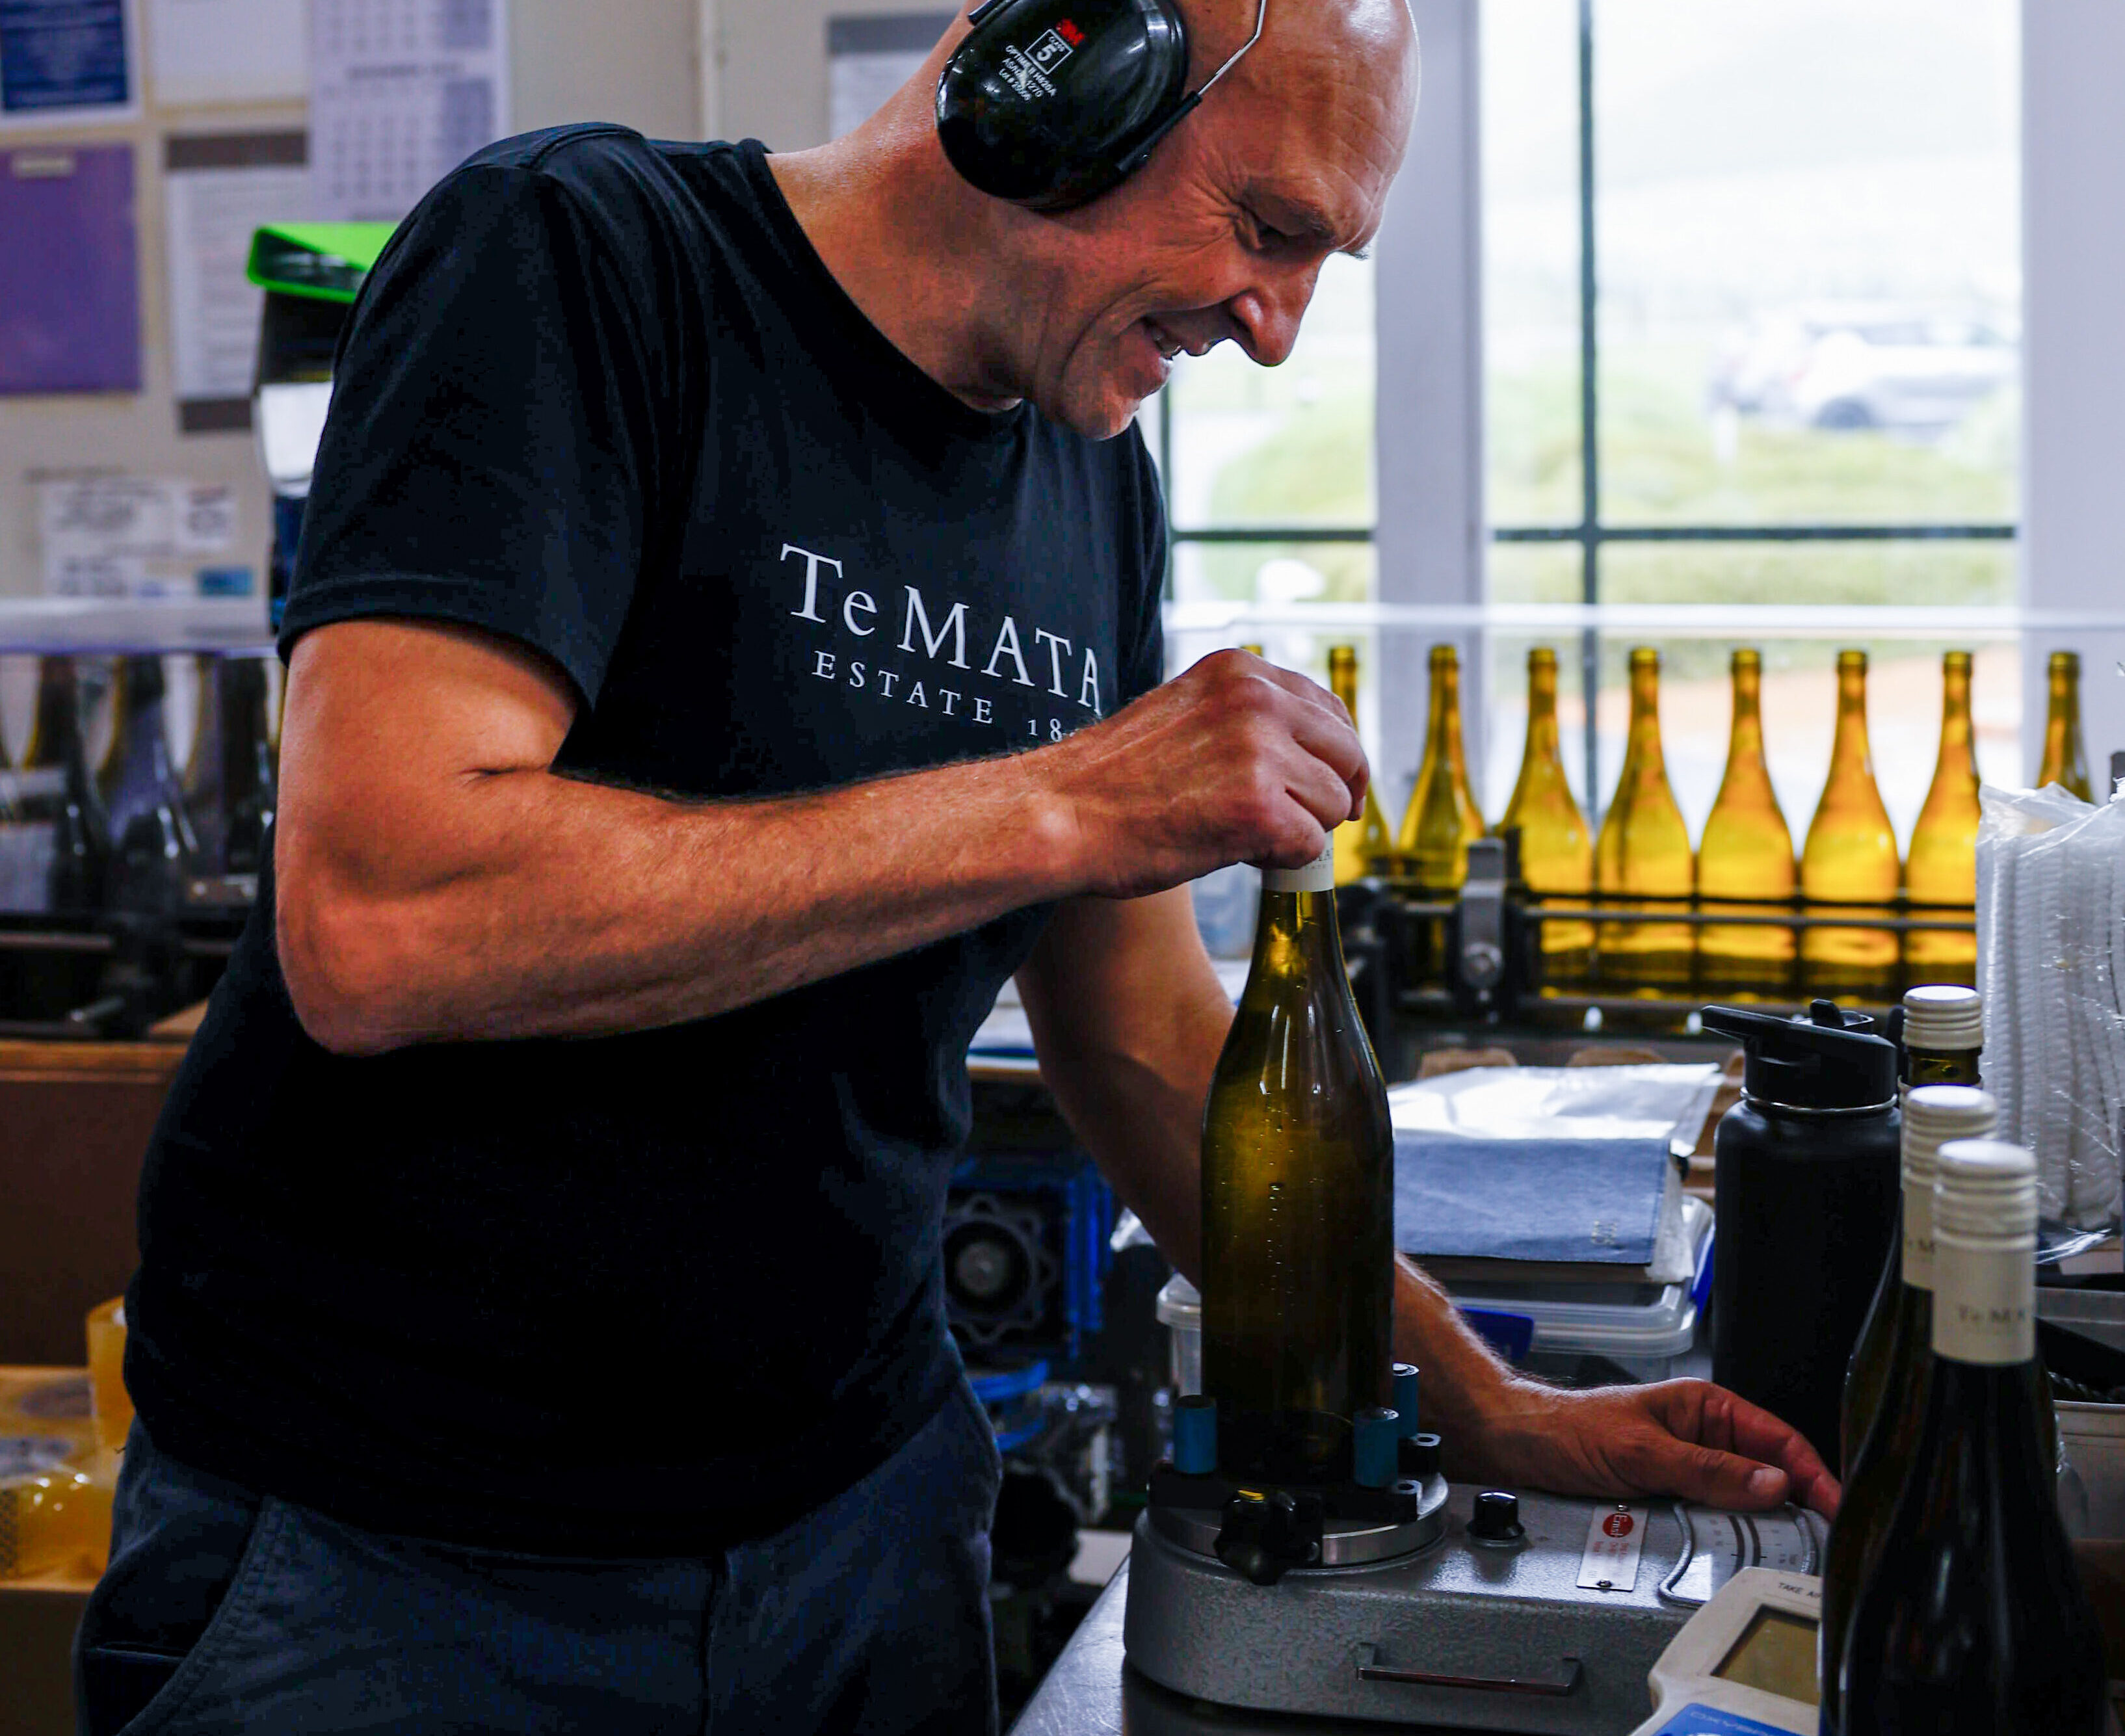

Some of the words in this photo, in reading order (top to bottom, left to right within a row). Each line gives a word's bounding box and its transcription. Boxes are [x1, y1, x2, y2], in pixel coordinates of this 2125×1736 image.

[1036, 44, 1057, 61] 5
[780, 543, 878, 637] Te
[897, 585, 1103, 718] MATA
[811, 650, 994, 724] ESTATE
[1027, 718, 1078, 743] 18
